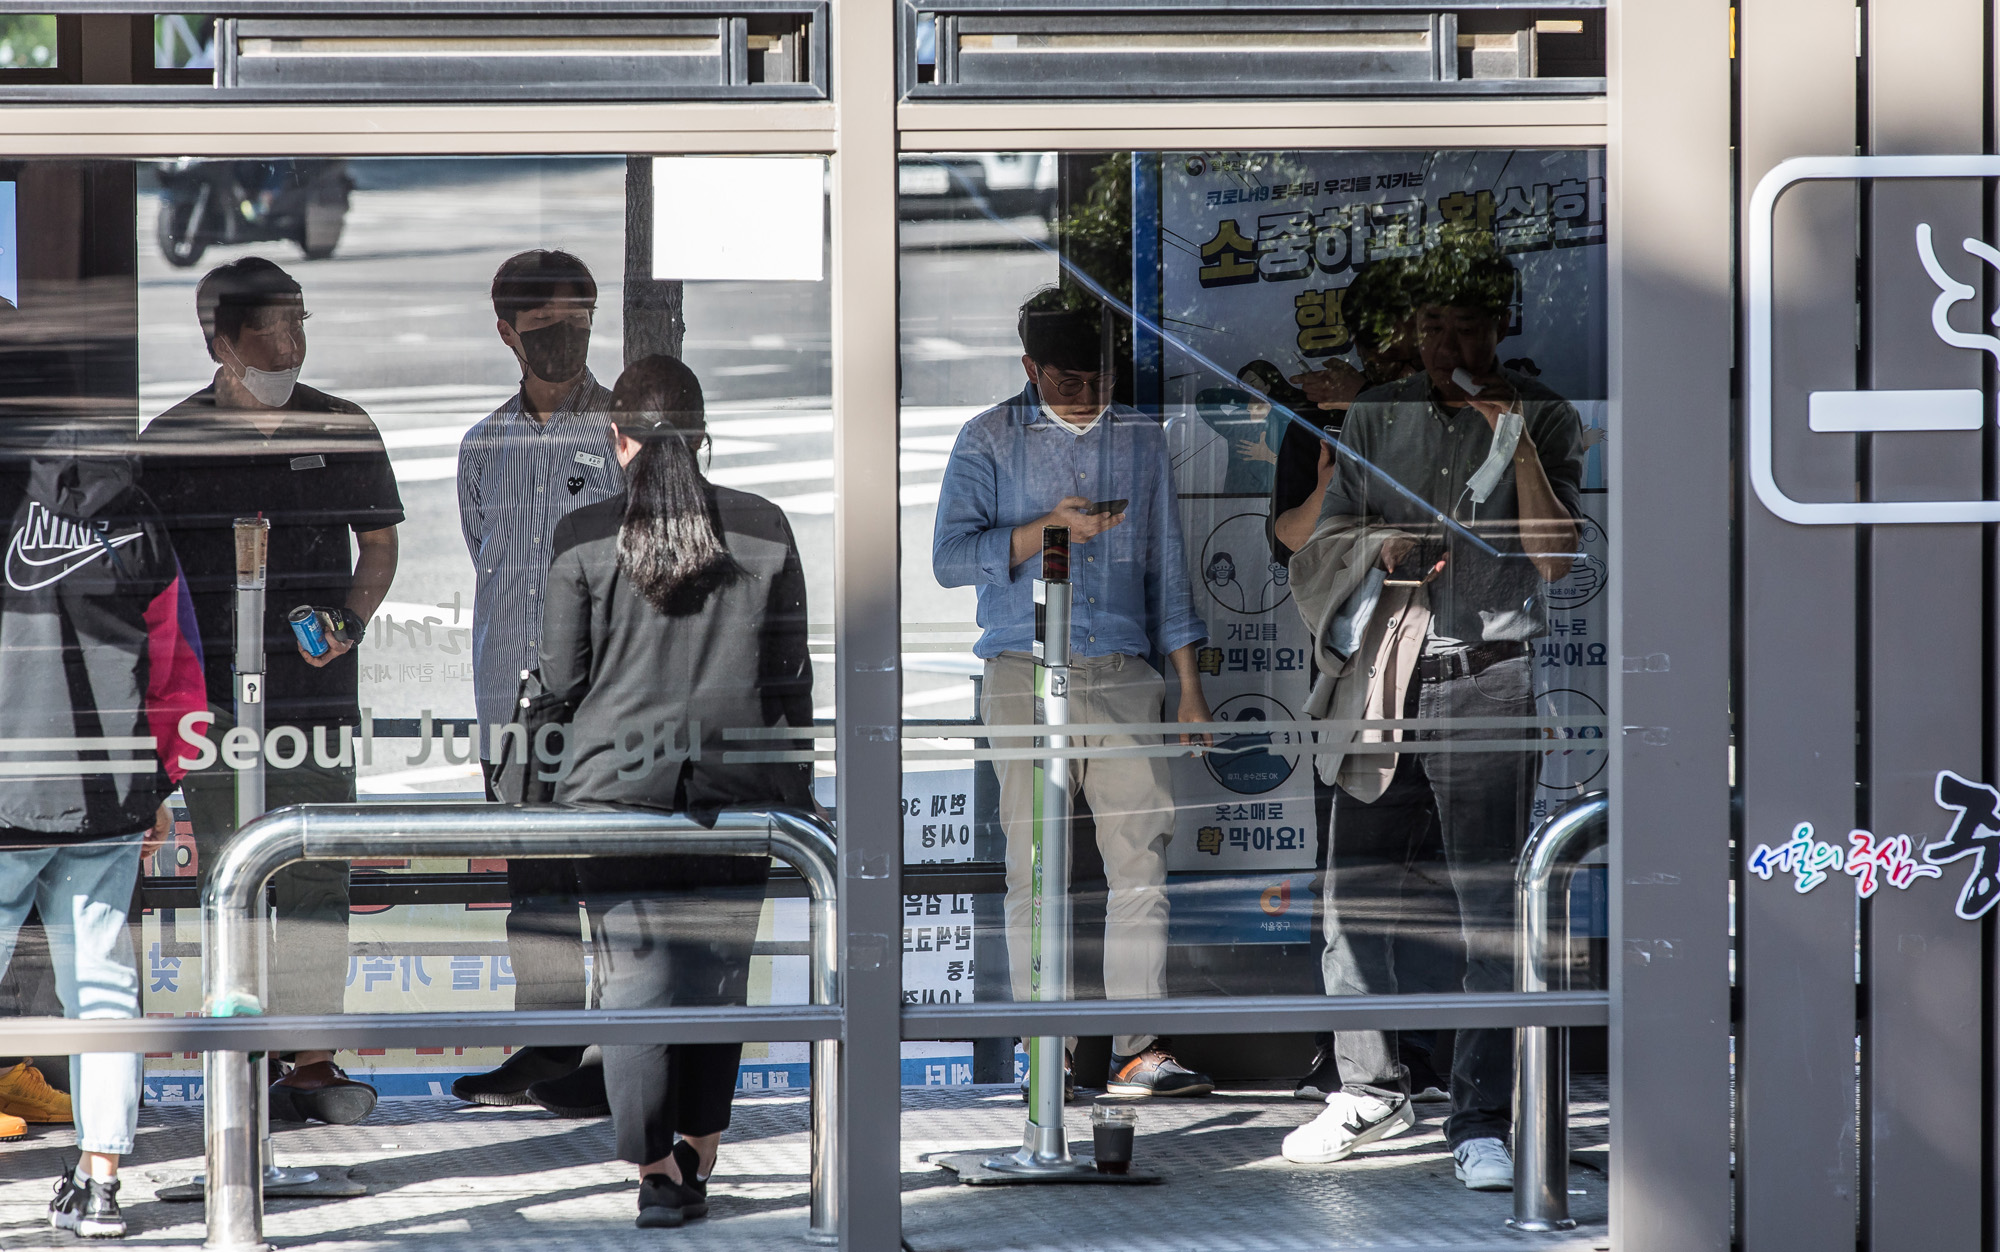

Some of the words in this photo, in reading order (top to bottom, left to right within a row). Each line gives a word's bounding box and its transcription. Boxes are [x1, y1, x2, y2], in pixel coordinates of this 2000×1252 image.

[1324, 175, 1372, 196] 우리를
[1375, 170, 1424, 191] 지키는
[1198, 198, 1430, 288] 소중하고
[1438, 176, 1606, 255] 확실한
[1227, 623, 1278, 642] 거리를
[1547, 618, 1588, 637] 누로
[1198, 646, 1225, 677] 확
[1228, 647, 1304, 673] 띄워요!
[1540, 642, 1608, 668] 씻어요
[177, 707, 373, 770] Seoul
[1268, 772, 1279, 781] OK
[1215, 803, 1284, 822] 옷소매로
[1196, 826, 1225, 856] 확
[1229, 826, 1305, 852] 막아요!
[1749, 822, 1844, 893] 서울의
[1845, 829, 1941, 898] 중심
[1260, 921, 1291, 932] 서울중구
